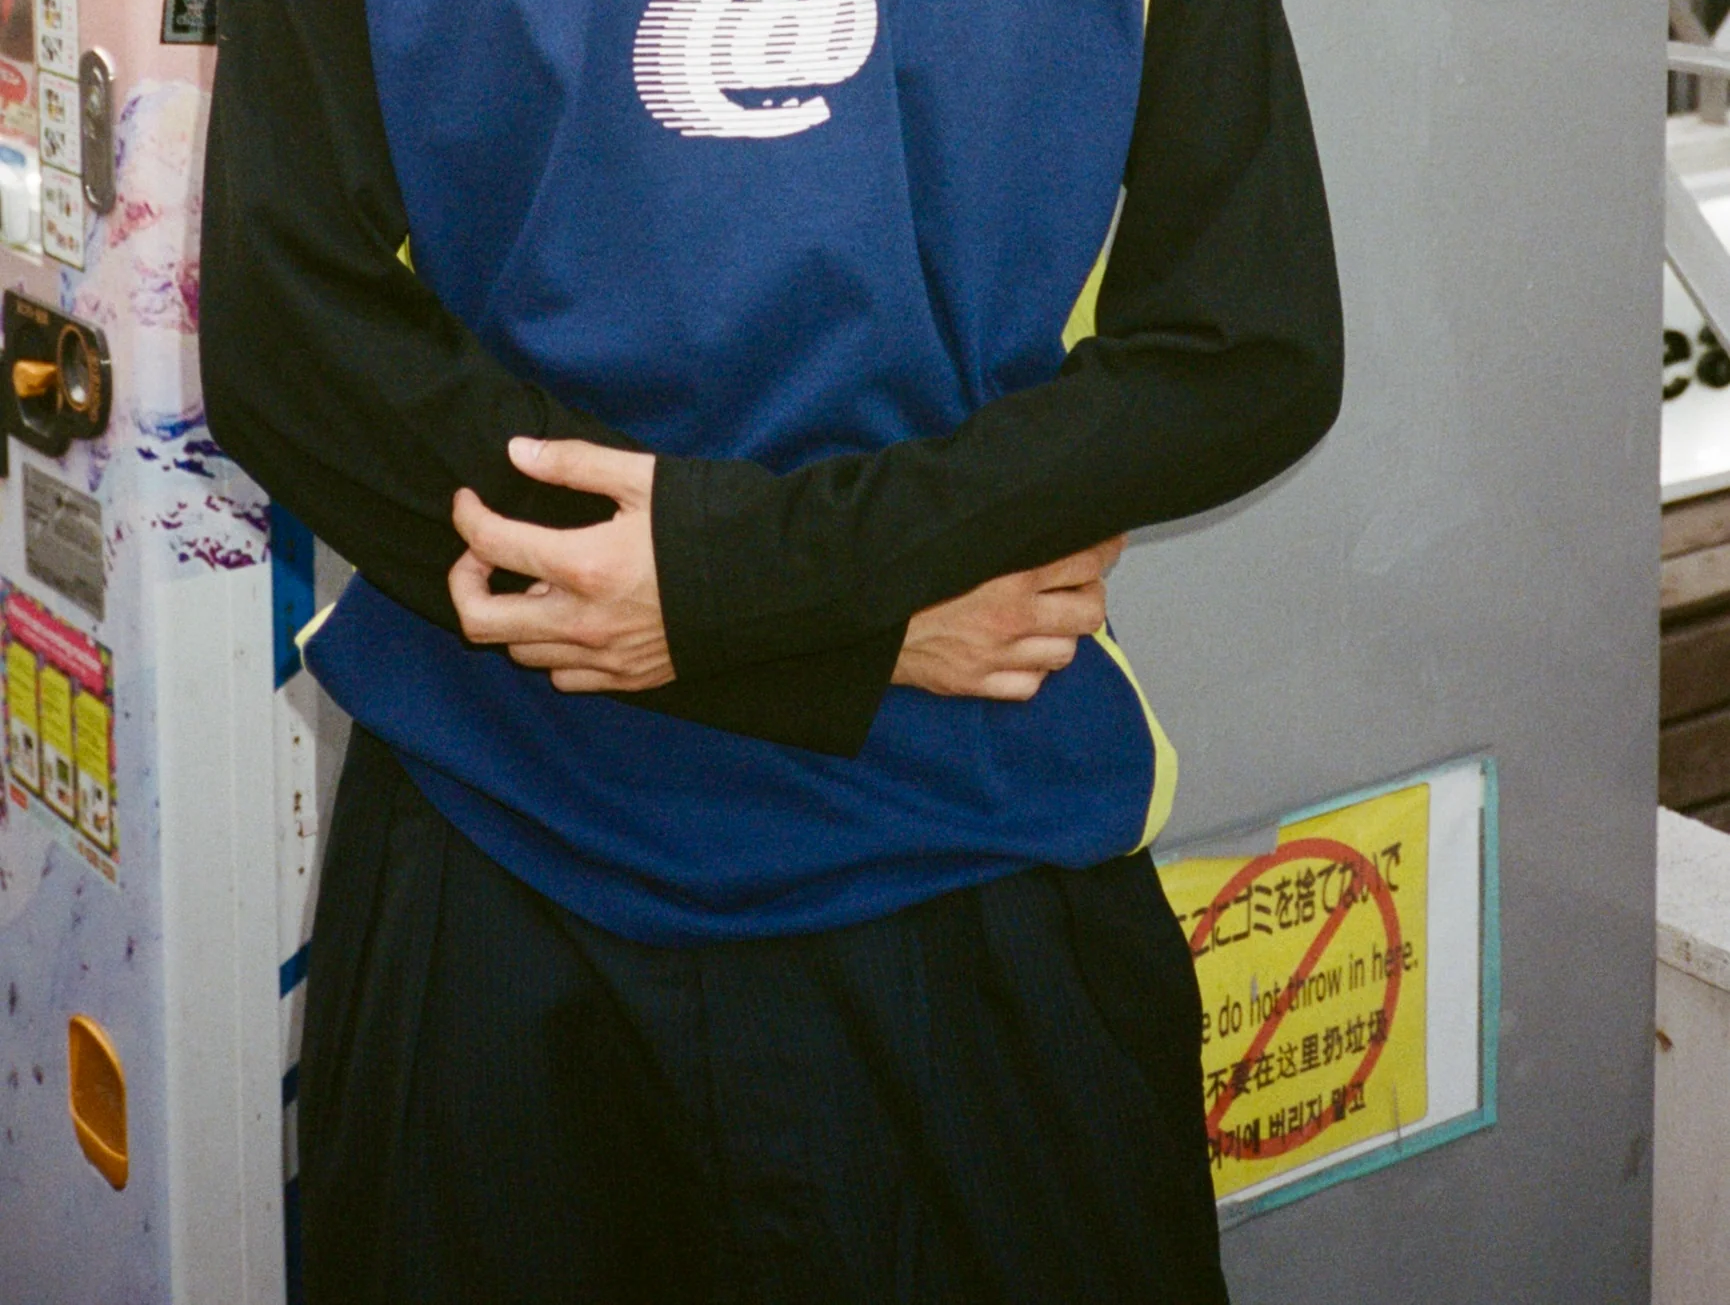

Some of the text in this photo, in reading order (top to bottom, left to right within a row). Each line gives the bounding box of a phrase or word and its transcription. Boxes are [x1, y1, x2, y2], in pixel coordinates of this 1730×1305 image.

[1218, 994, 1242, 1038] do
[1249, 980, 1282, 1027] not
[1288, 966, 1343, 1012] throw
[1348, 952, 1365, 991] in
[1371, 941, 1418, 984] here.
